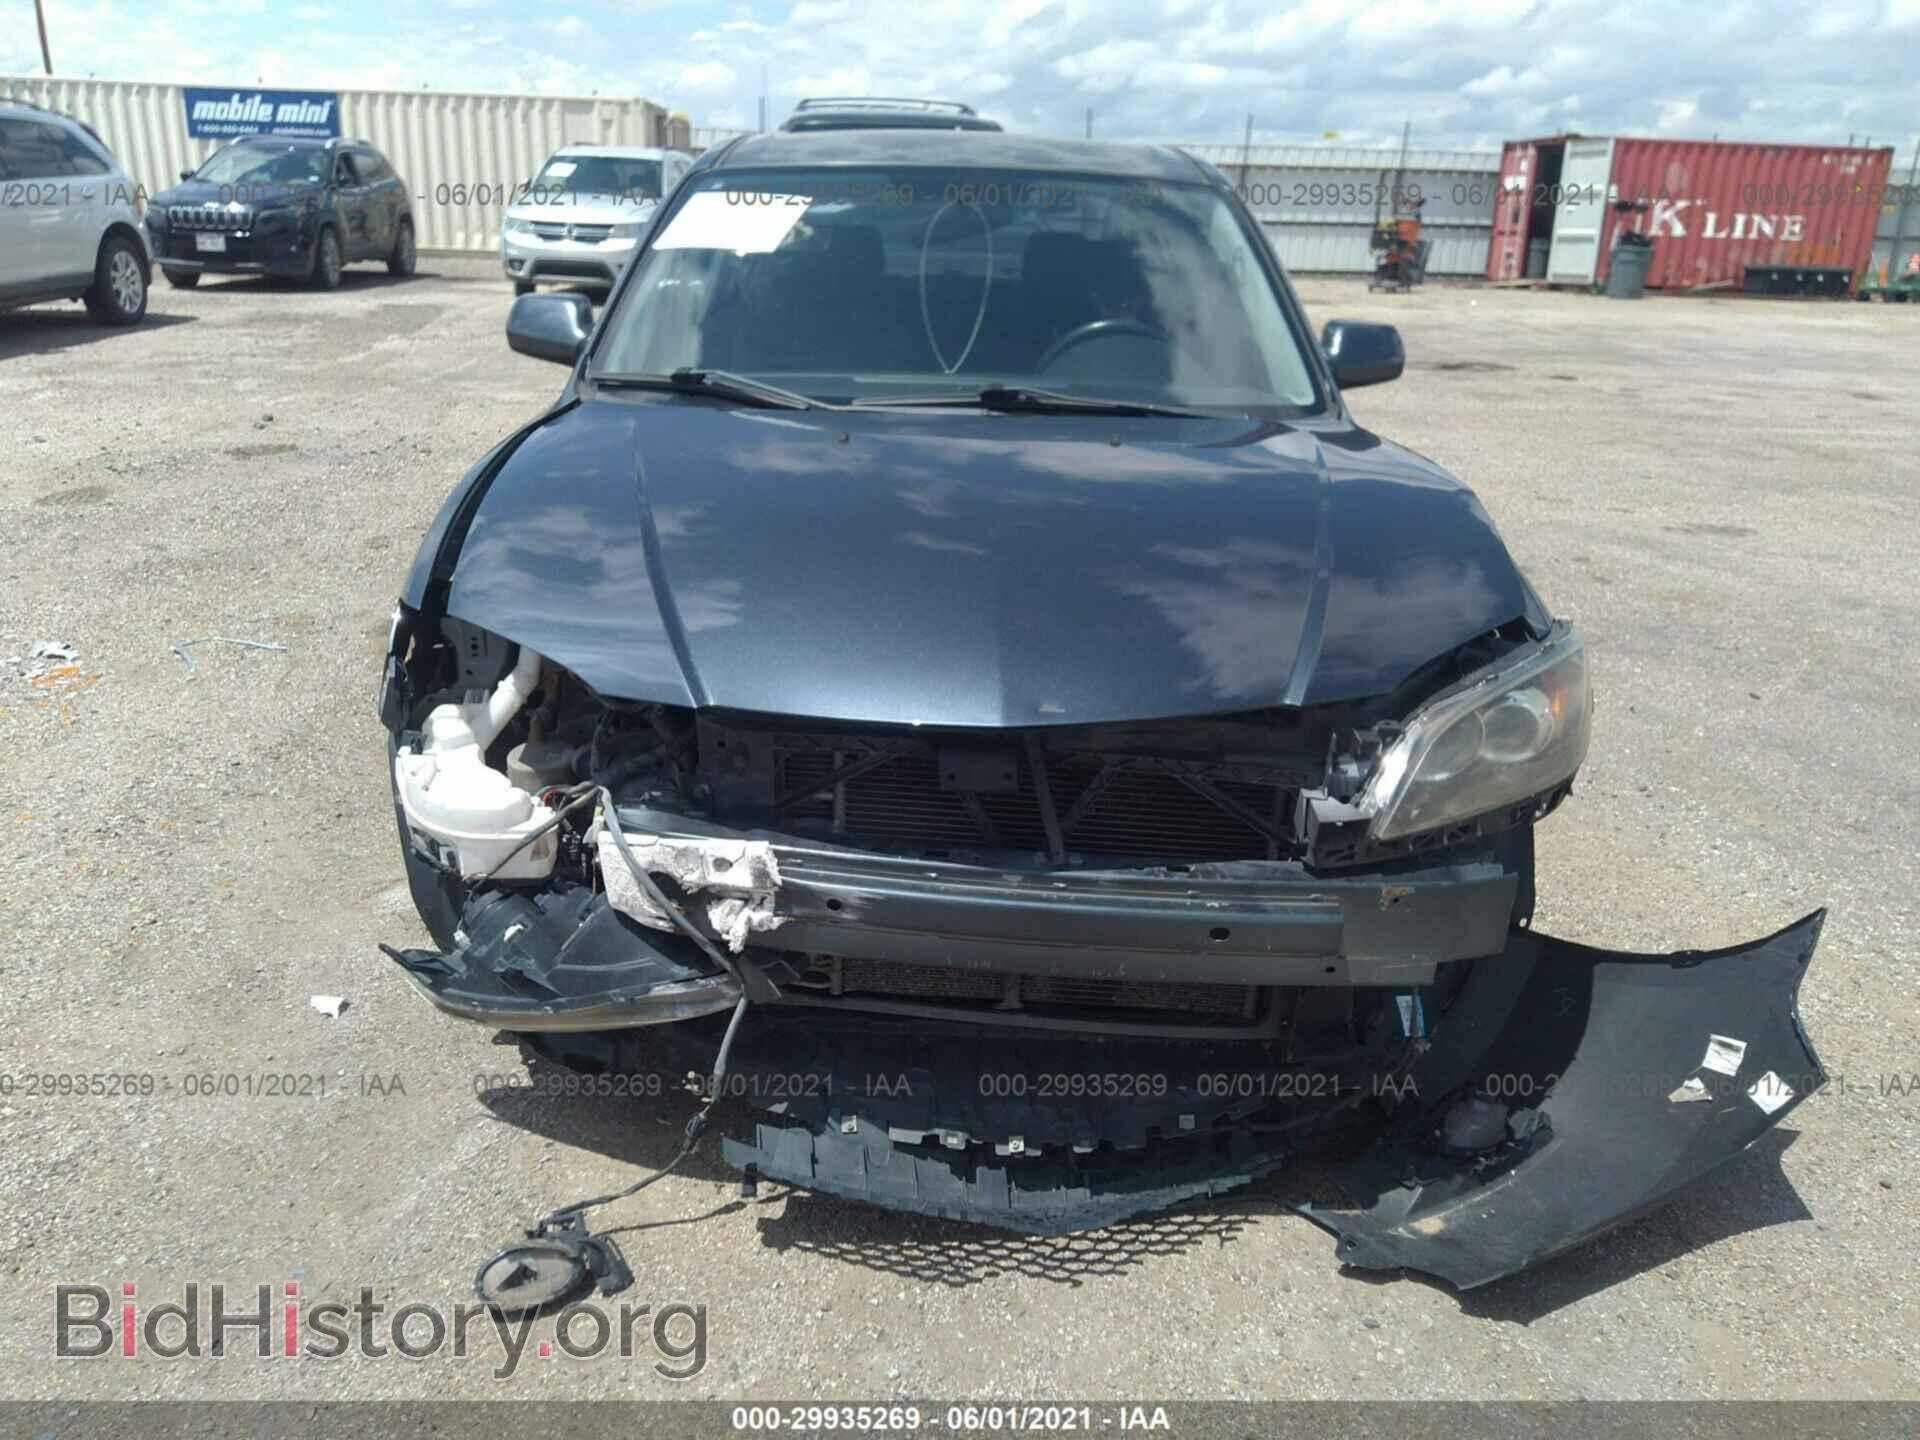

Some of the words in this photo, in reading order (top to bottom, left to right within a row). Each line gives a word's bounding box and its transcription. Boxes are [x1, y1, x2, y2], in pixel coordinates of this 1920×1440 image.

[192, 93, 274, 122] mobile
[275, 99, 334, 123] mini
[1702, 211, 1806, 241] LINE
